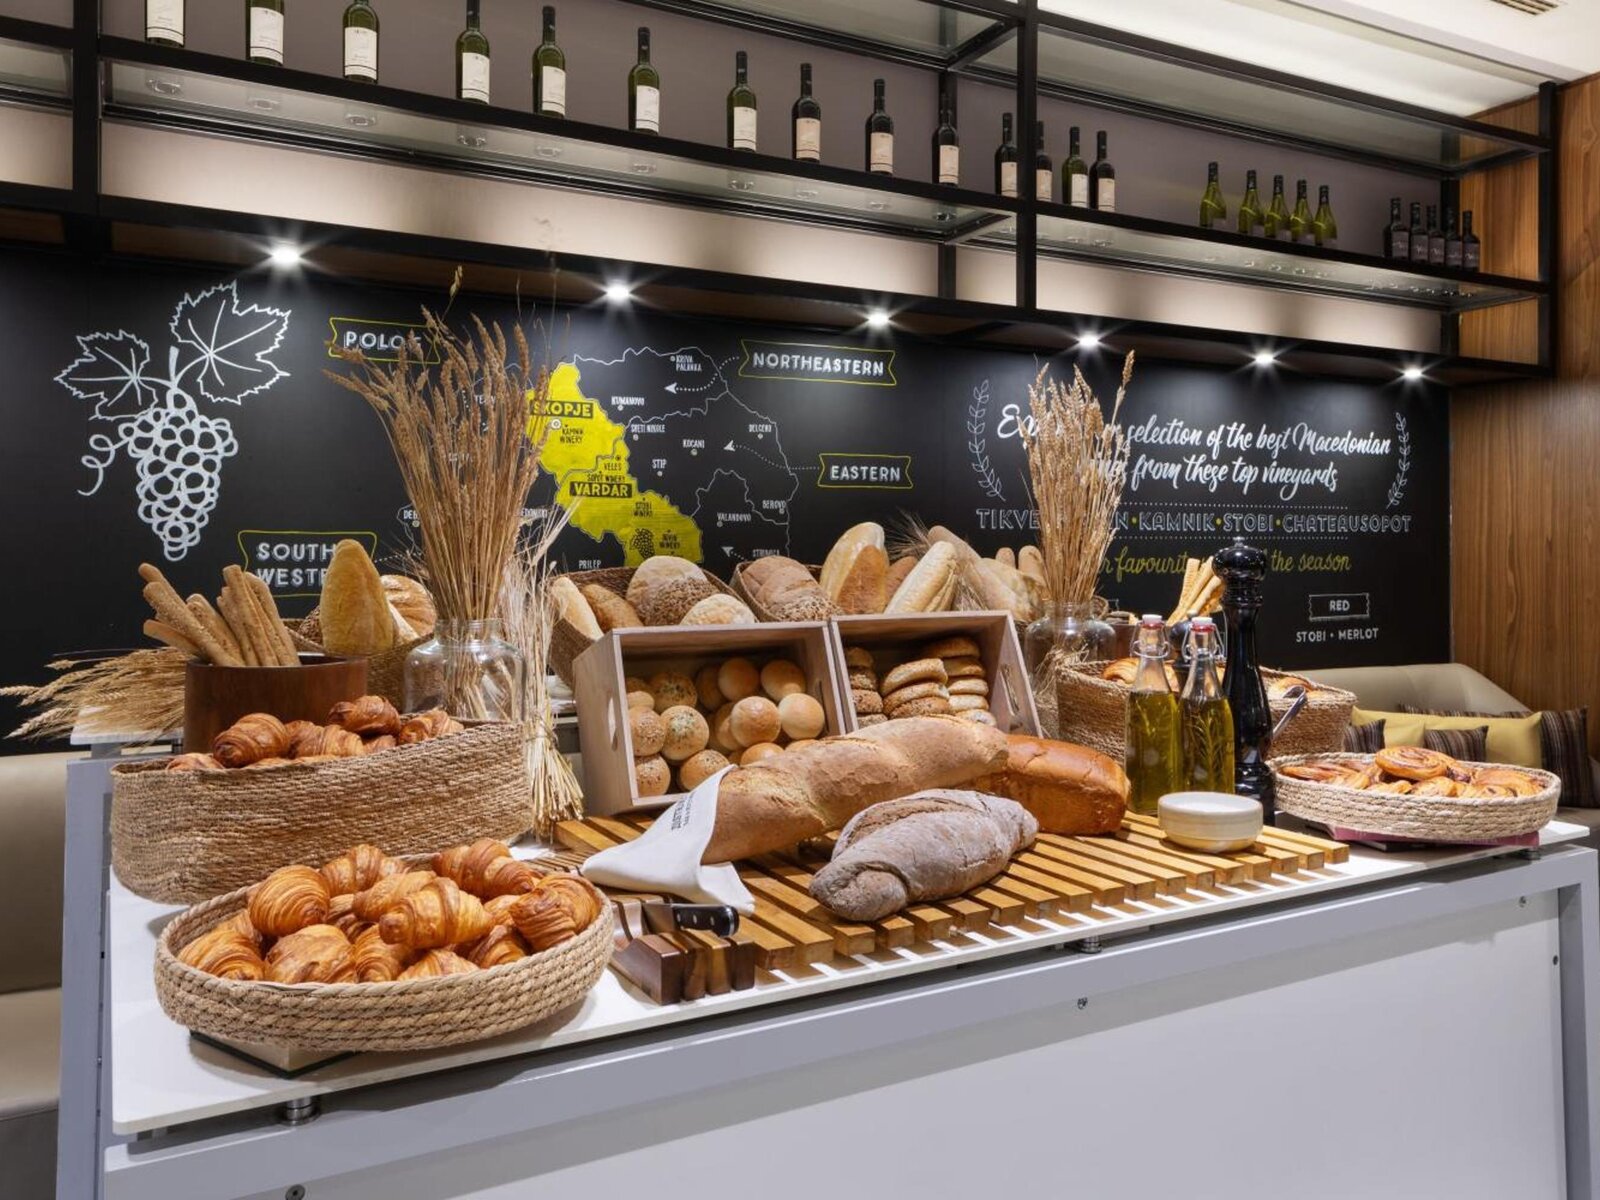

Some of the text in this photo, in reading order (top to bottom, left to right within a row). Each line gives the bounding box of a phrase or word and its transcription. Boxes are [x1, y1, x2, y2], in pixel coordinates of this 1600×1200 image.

[343, 331, 421, 350] POLO
[753, 352, 884, 377] NORTHEASTERN
[611, 396, 645, 406] KUMANOVO
[1122, 414, 1201, 450] selection
[1206, 423, 1226, 460] of
[1226, 422, 1253, 451] the
[1256, 424, 1292, 459] best
[1292, 422, 1392, 456] Macedonian
[651, 459, 667, 469] STIP
[830, 465, 900, 481] EASTERN
[1130, 454, 1182, 491] from
[1183, 454, 1229, 493] these
[1232, 456, 1258, 495] top
[1262, 461, 1339, 501] vineyards
[574, 483, 628, 496] VARDAR
[976, 509, 1041, 530] TIKVE
[1139, 511, 1215, 532] KAMNIK
[1223, 513, 1273, 532] STOBI
[1116, 546, 1188, 583] favourit
[1270, 549, 1294, 572] the
[1299, 553, 1352, 572] season
[1329, 600, 1350, 612] RED
[1296, 628, 1379, 642] STOBI MERLOT
